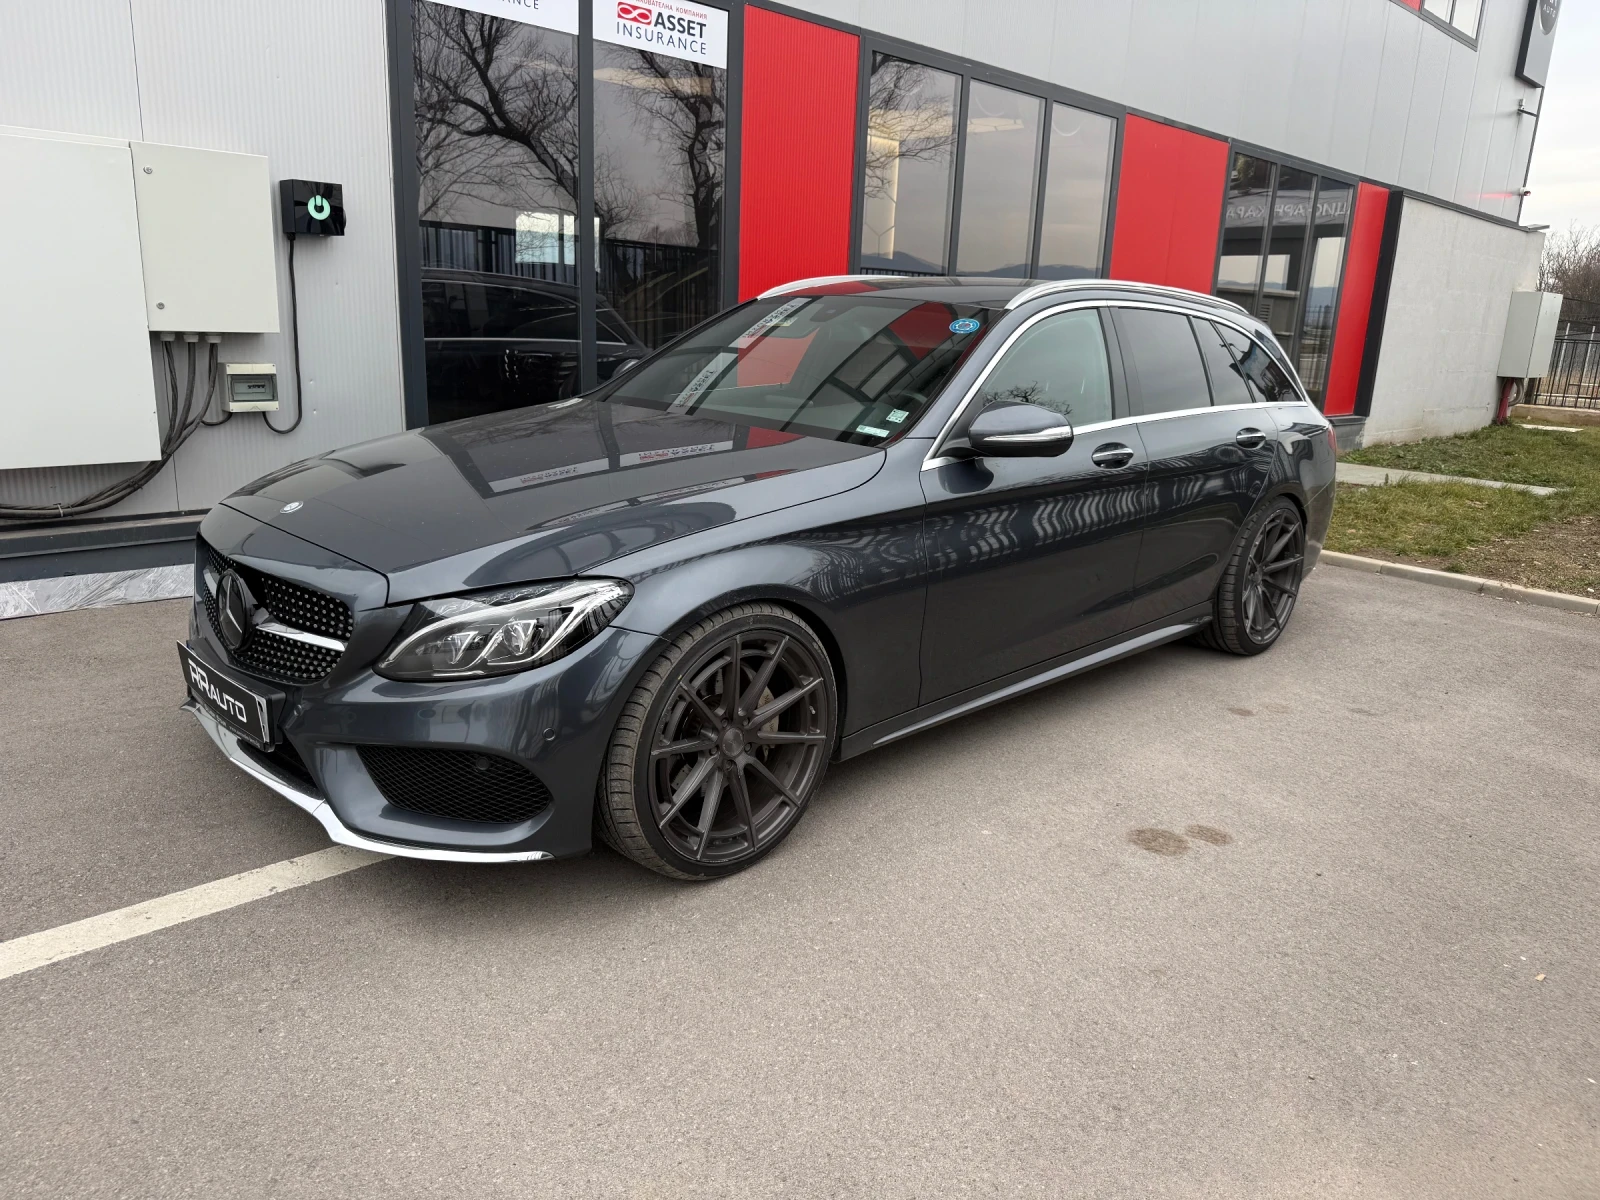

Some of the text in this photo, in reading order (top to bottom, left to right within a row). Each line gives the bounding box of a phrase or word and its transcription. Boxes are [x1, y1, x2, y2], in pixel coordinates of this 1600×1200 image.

[675, 7, 708, 20] КОМПАНИЯ
[1542, 3, 1557, 18] AUTO
[653, 11, 707, 39] ASSET
[616, 21, 707, 55] INSURANCE
